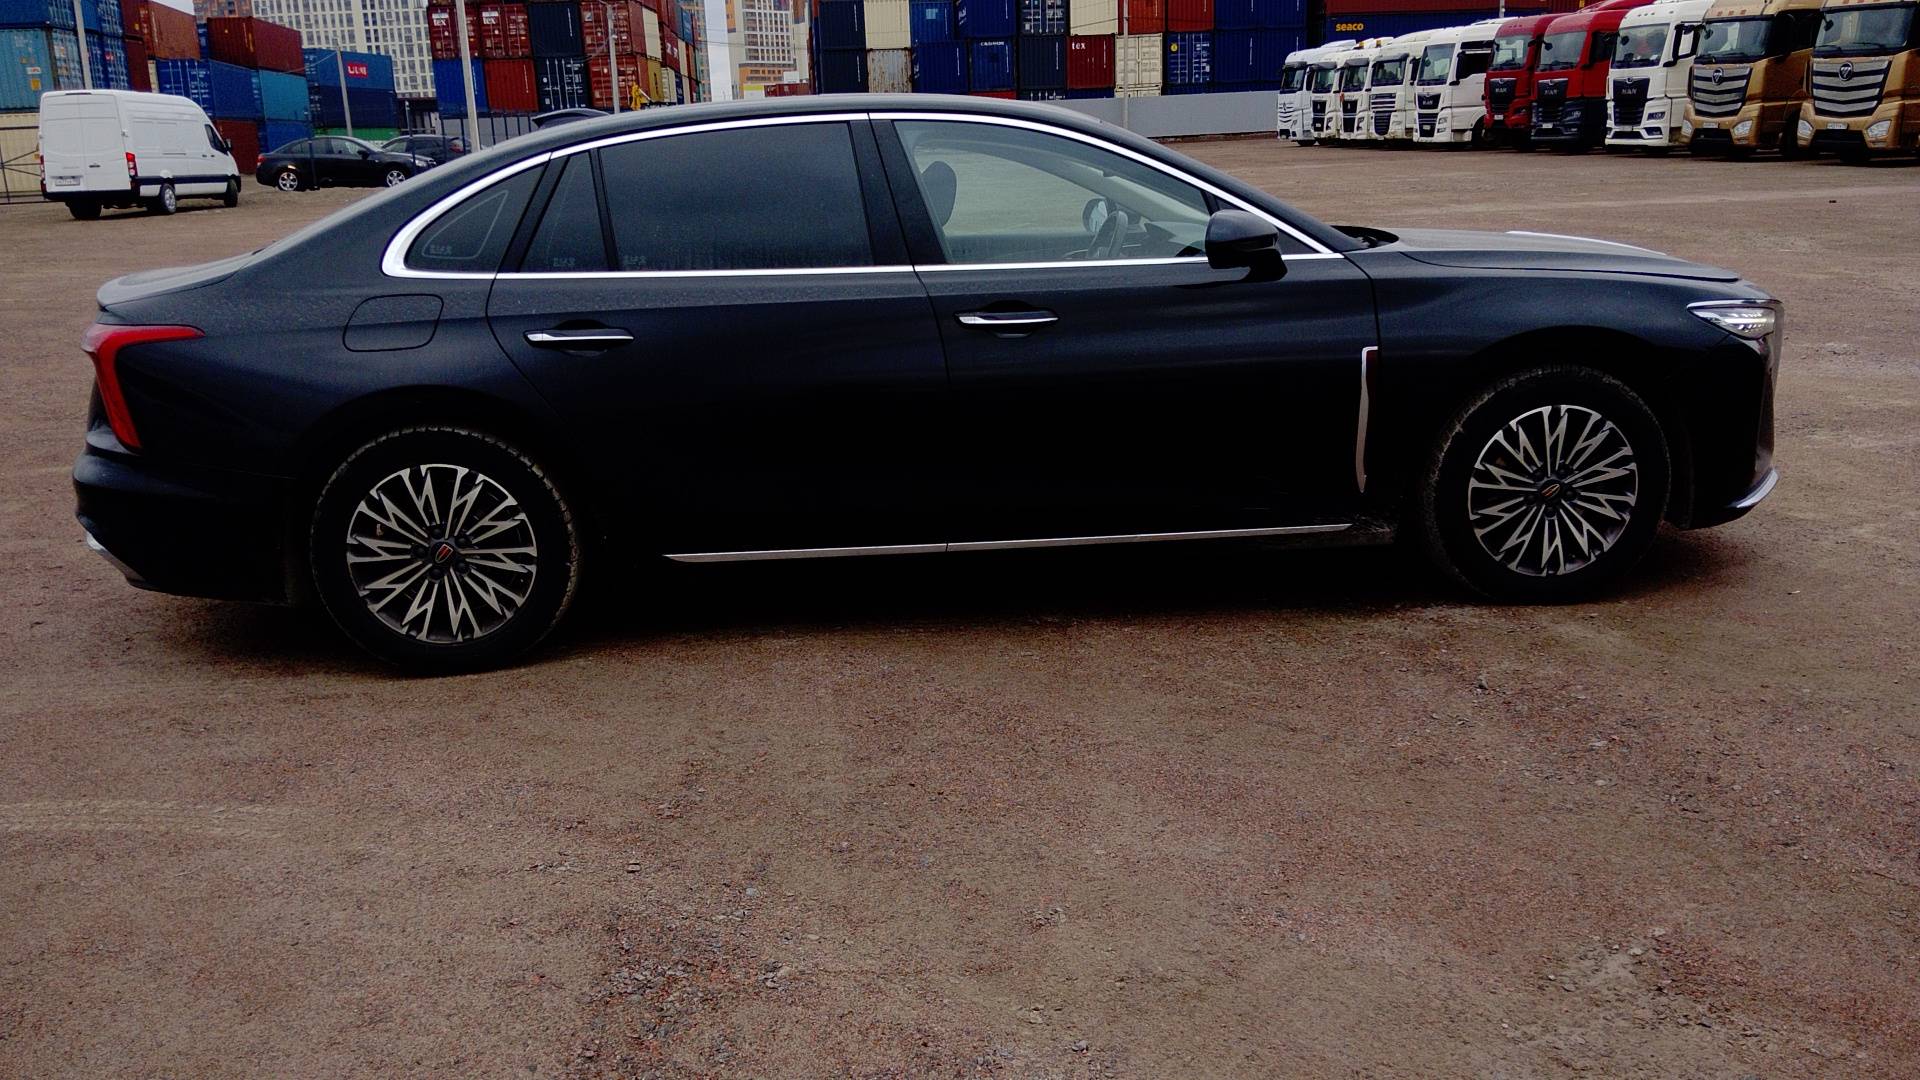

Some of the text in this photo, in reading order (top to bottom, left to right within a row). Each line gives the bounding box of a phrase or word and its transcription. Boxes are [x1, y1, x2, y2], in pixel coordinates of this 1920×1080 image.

[483, 17, 496, 25] tex
[1335, 23, 1364, 31] seaco
[1072, 42, 1086, 50] tex
